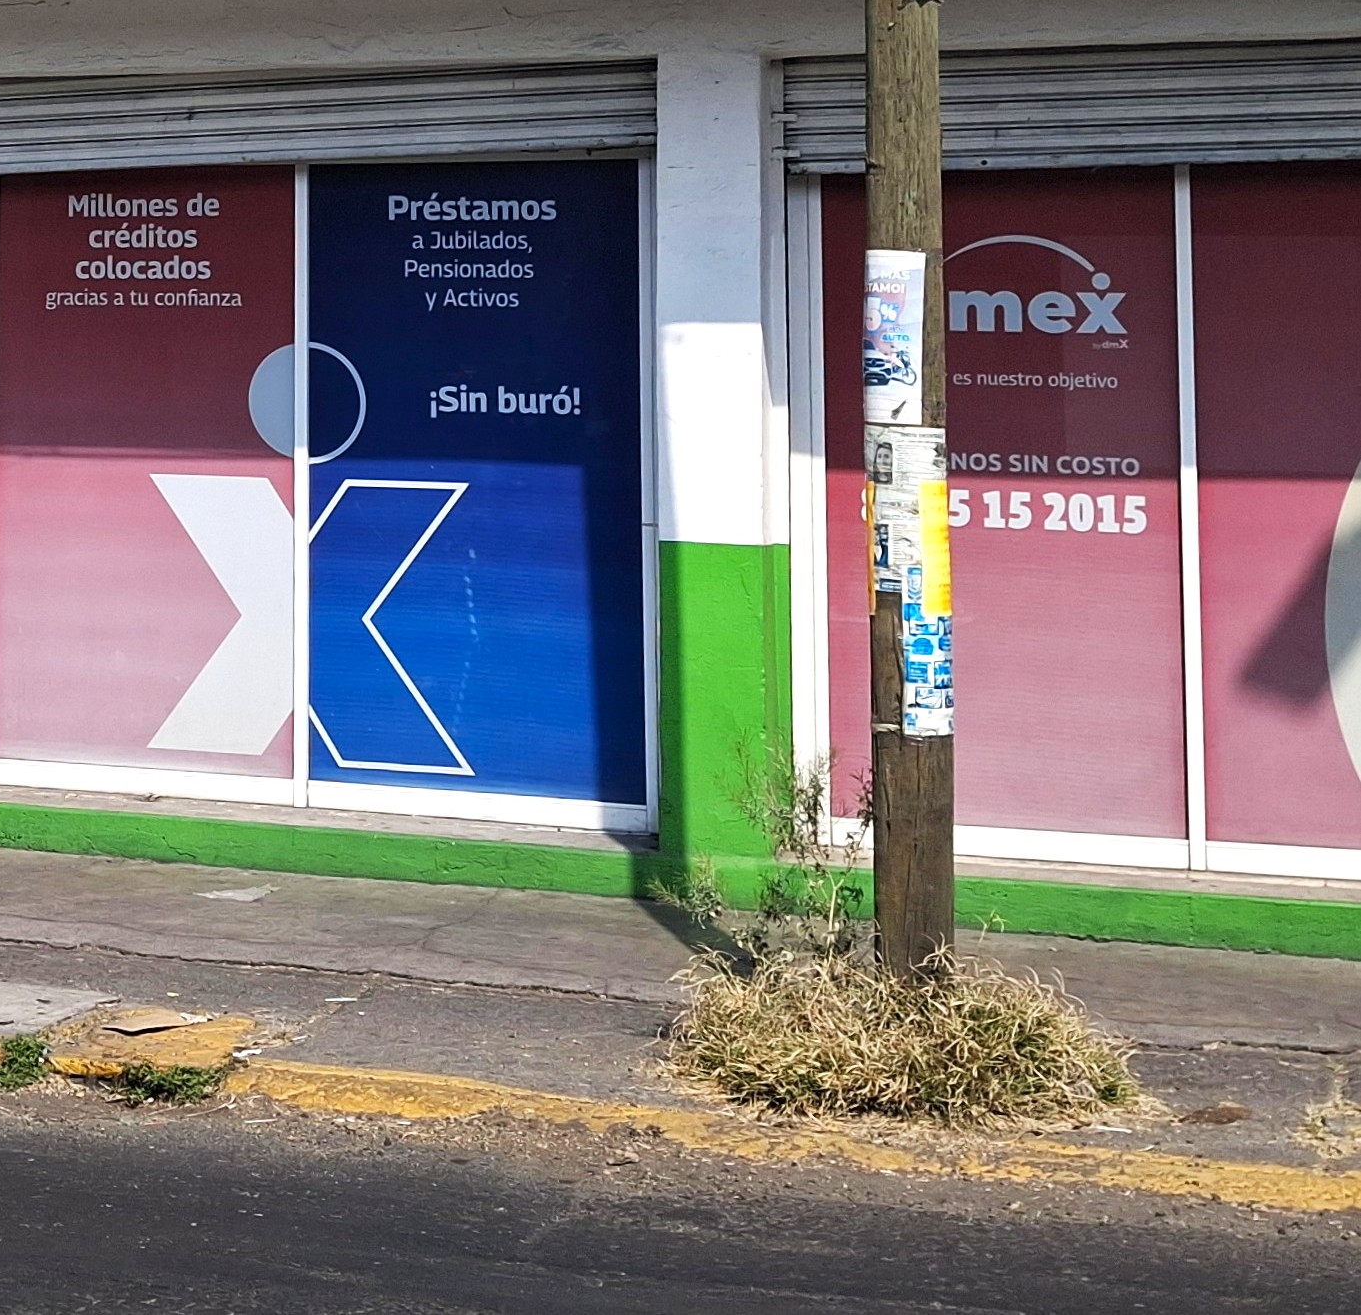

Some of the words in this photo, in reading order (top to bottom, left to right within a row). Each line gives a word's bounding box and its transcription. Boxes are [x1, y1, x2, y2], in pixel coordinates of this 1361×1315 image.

[68, 193, 178, 218] Millones
[186, 192, 220, 217] de
[388, 192, 557, 221] Préstamos
[88, 222, 198, 249] créditos
[412, 235, 424, 249] a
[430, 230, 533, 254] Jubilados,
[75, 255, 212, 280] colocados
[404, 258, 534, 279] Pensionados
[45, 288, 108, 310] gracias
[113, 292, 125, 306] a
[129, 290, 149, 306] tu
[154, 288, 242, 307] confianza
[425, 291, 437, 312] y
[443, 287, 519, 308] Activos
[948, 272, 1129, 334] mex
[1102, 339, 1129, 349] dmX
[952, 373, 972, 385] es
[977, 372, 1043, 386] nuestro
[1048, 372, 1118, 391] objetivo
[429, 384, 488, 419] ¡Sin
[498, 385, 581, 415] buró!
[949, 452, 1002, 472] NOS
[1009, 454, 1049, 474] SIN
[1056, 455, 1140, 477] COSTO
[982, 490, 1033, 530] 15
[1042, 492, 1148, 534] 2015
